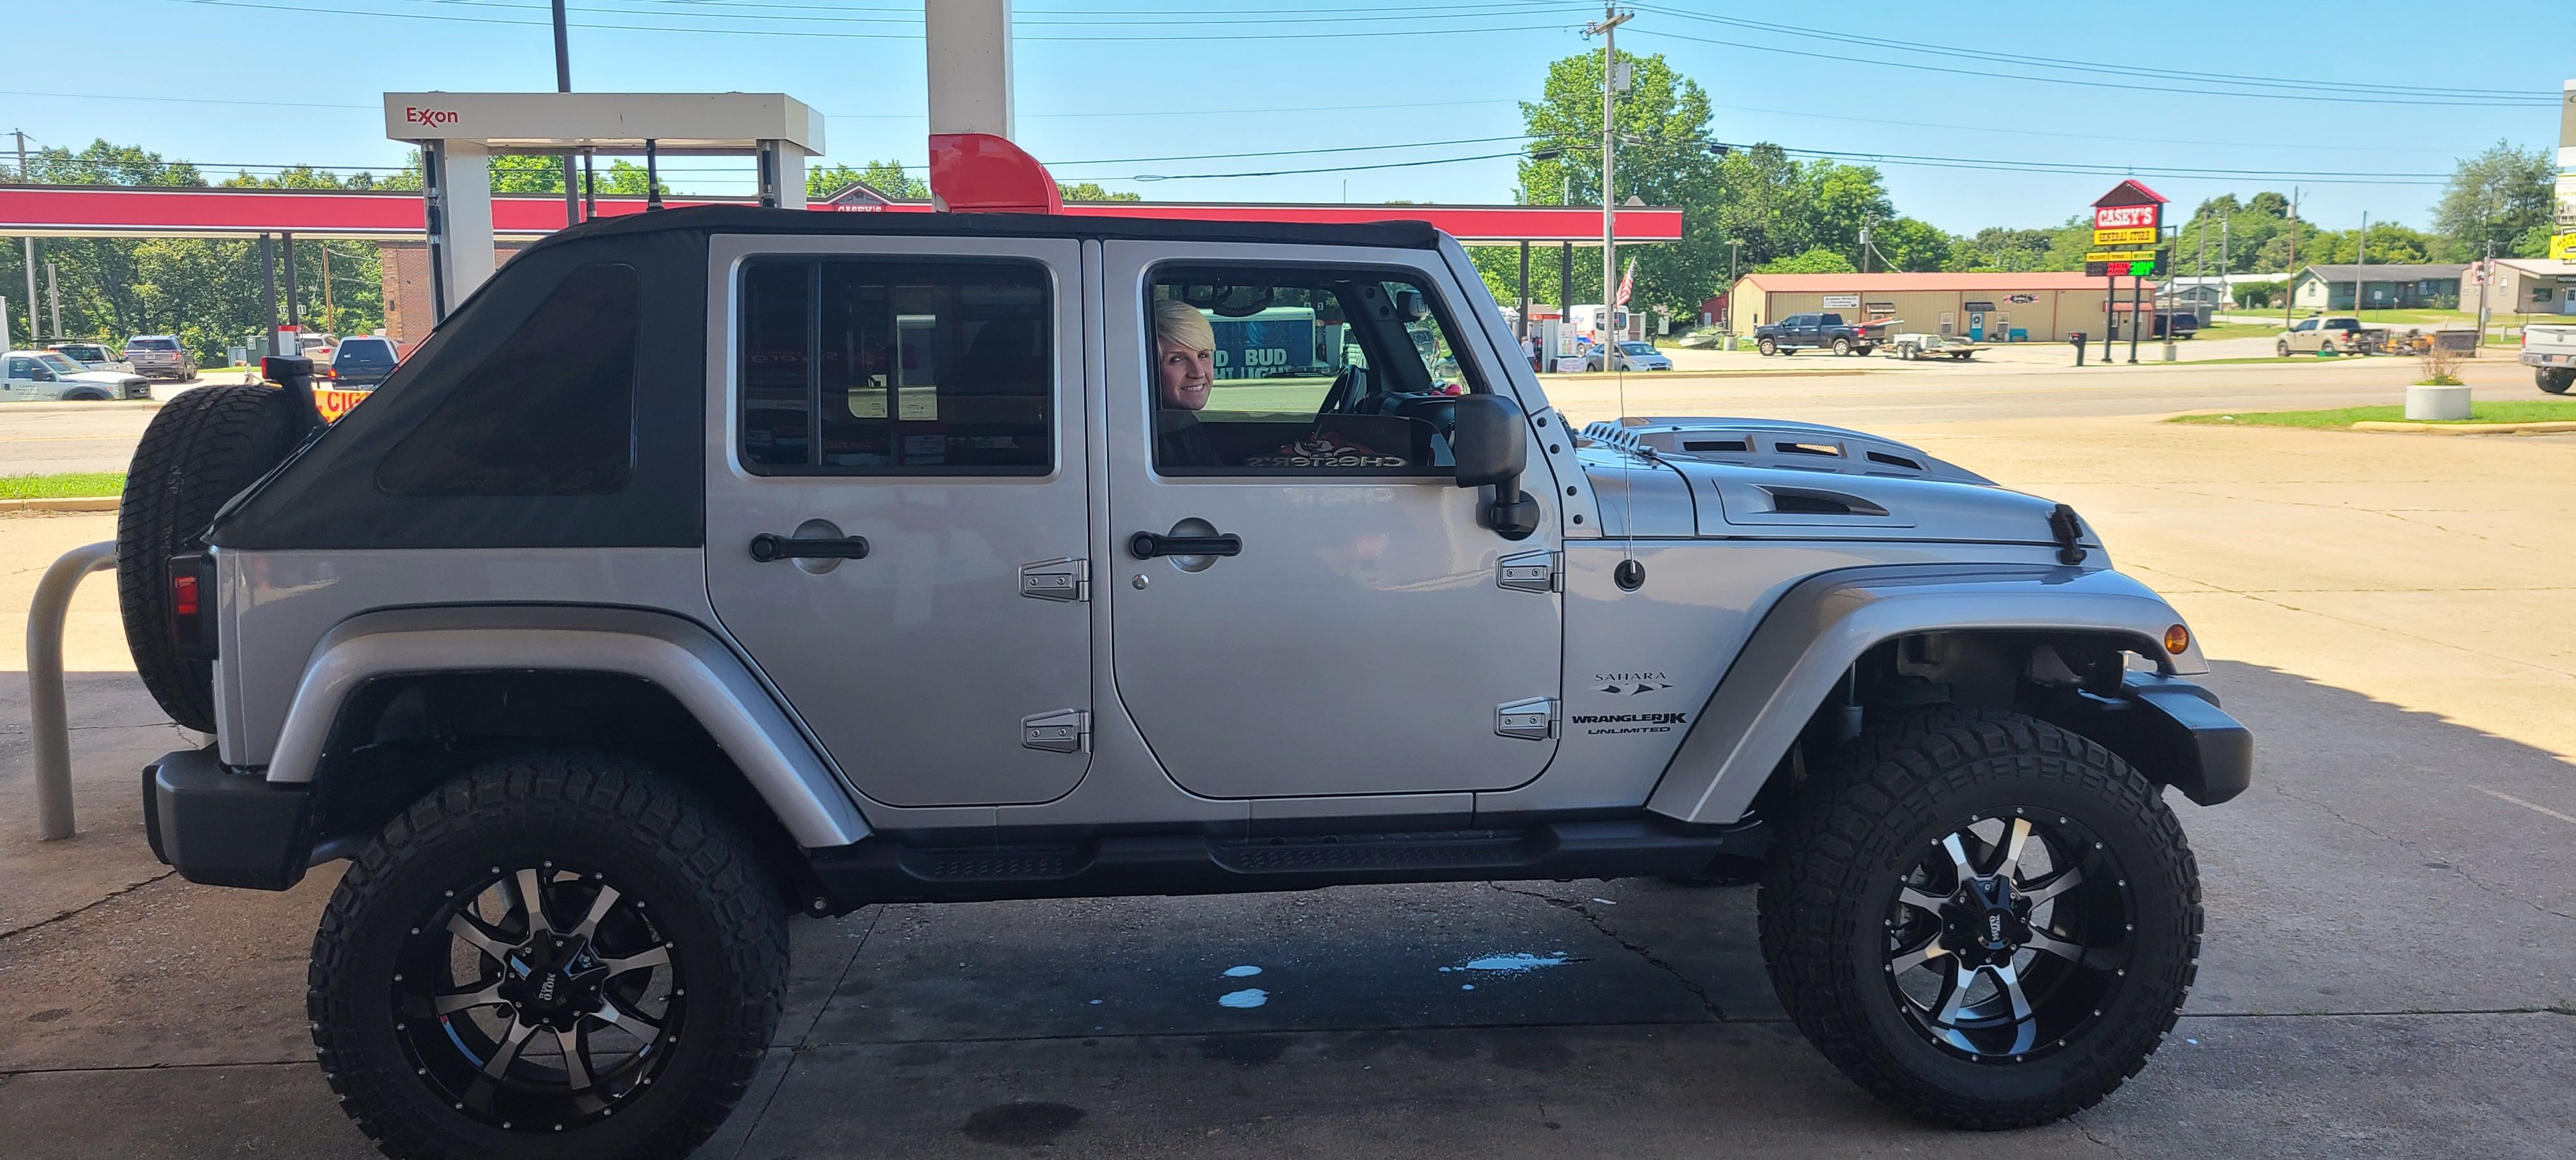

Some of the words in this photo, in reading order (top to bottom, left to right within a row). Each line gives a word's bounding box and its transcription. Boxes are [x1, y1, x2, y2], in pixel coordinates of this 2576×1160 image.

[406, 107, 459, 128] Exxon
[2098, 206, 2154, 227] CASEY'S
[1245, 348, 1287, 366] BUD
[1595, 672, 1667, 682] SAHARA
[1588, 726, 1671, 735] UNLIMITED
[1989, 915, 2000, 942] MOTO
[543, 972, 556, 1001] MOTO
